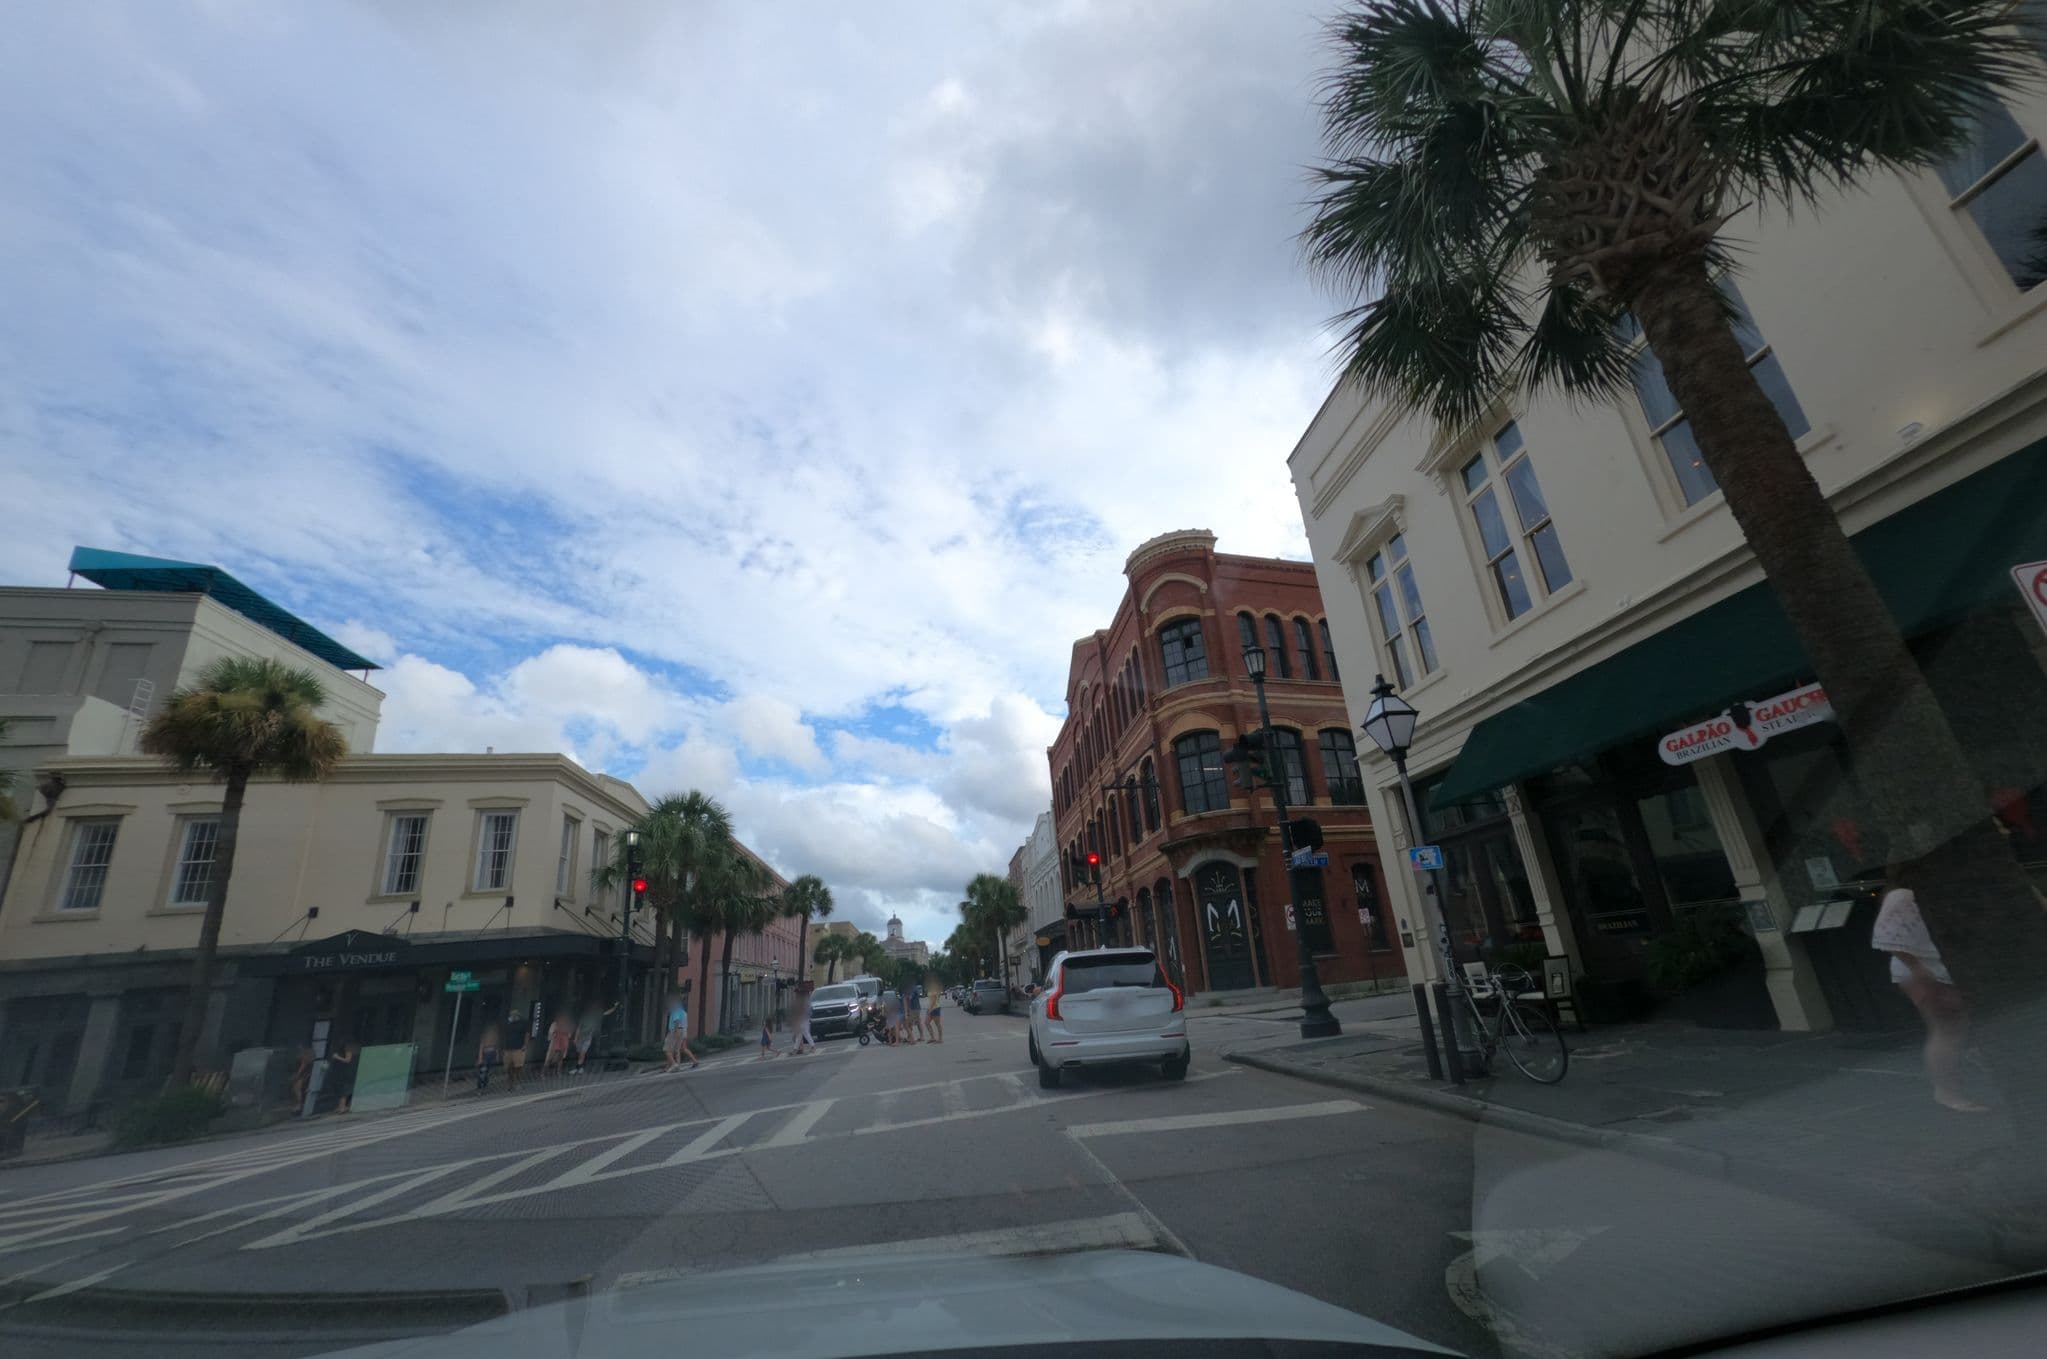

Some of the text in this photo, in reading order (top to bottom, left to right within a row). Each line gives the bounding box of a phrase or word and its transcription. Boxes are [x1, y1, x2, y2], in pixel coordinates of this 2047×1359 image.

[1666, 689, 1825, 753] GALPÃO GAUCH
[1675, 736, 1731, 761] BRAZILIAN
[304, 951, 397, 968] THE VENDUE
